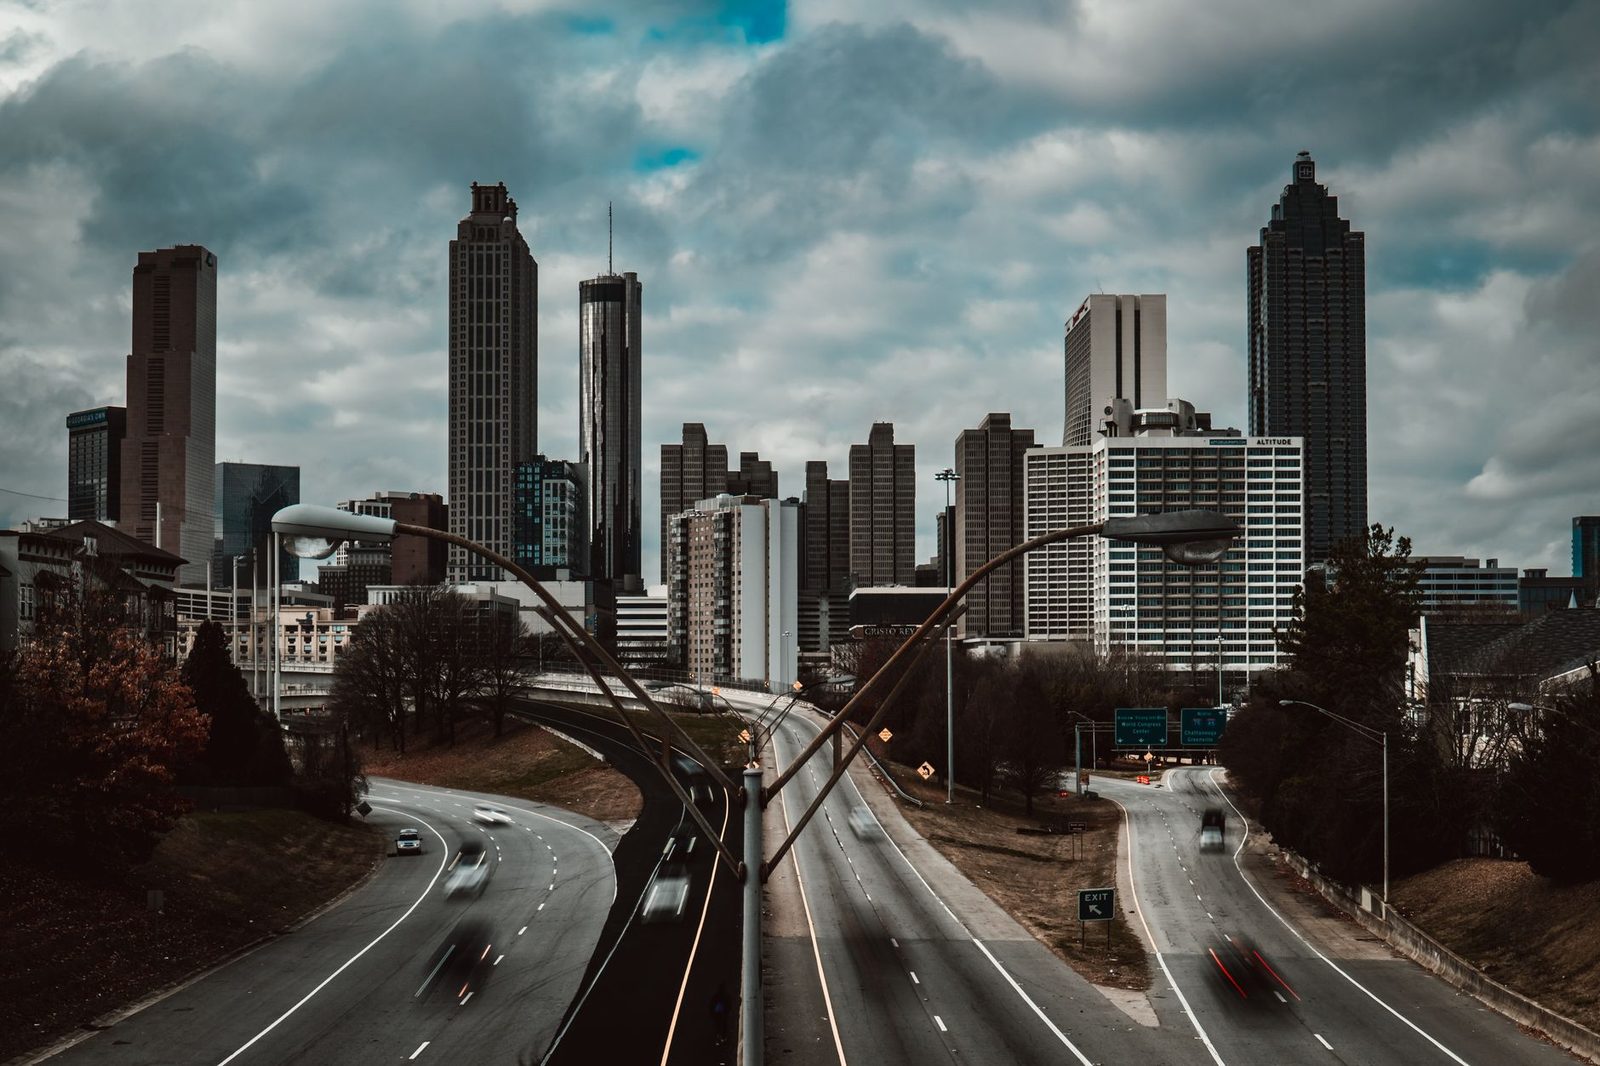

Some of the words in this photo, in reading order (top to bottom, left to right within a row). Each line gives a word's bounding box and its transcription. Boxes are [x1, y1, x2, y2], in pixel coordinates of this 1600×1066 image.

[864, 627, 896, 635] CRISTO
[899, 627, 915, 635] REY
[1184, 729, 1217, 737] Chattanooga
[1084, 893, 1109, 902] EXIT
